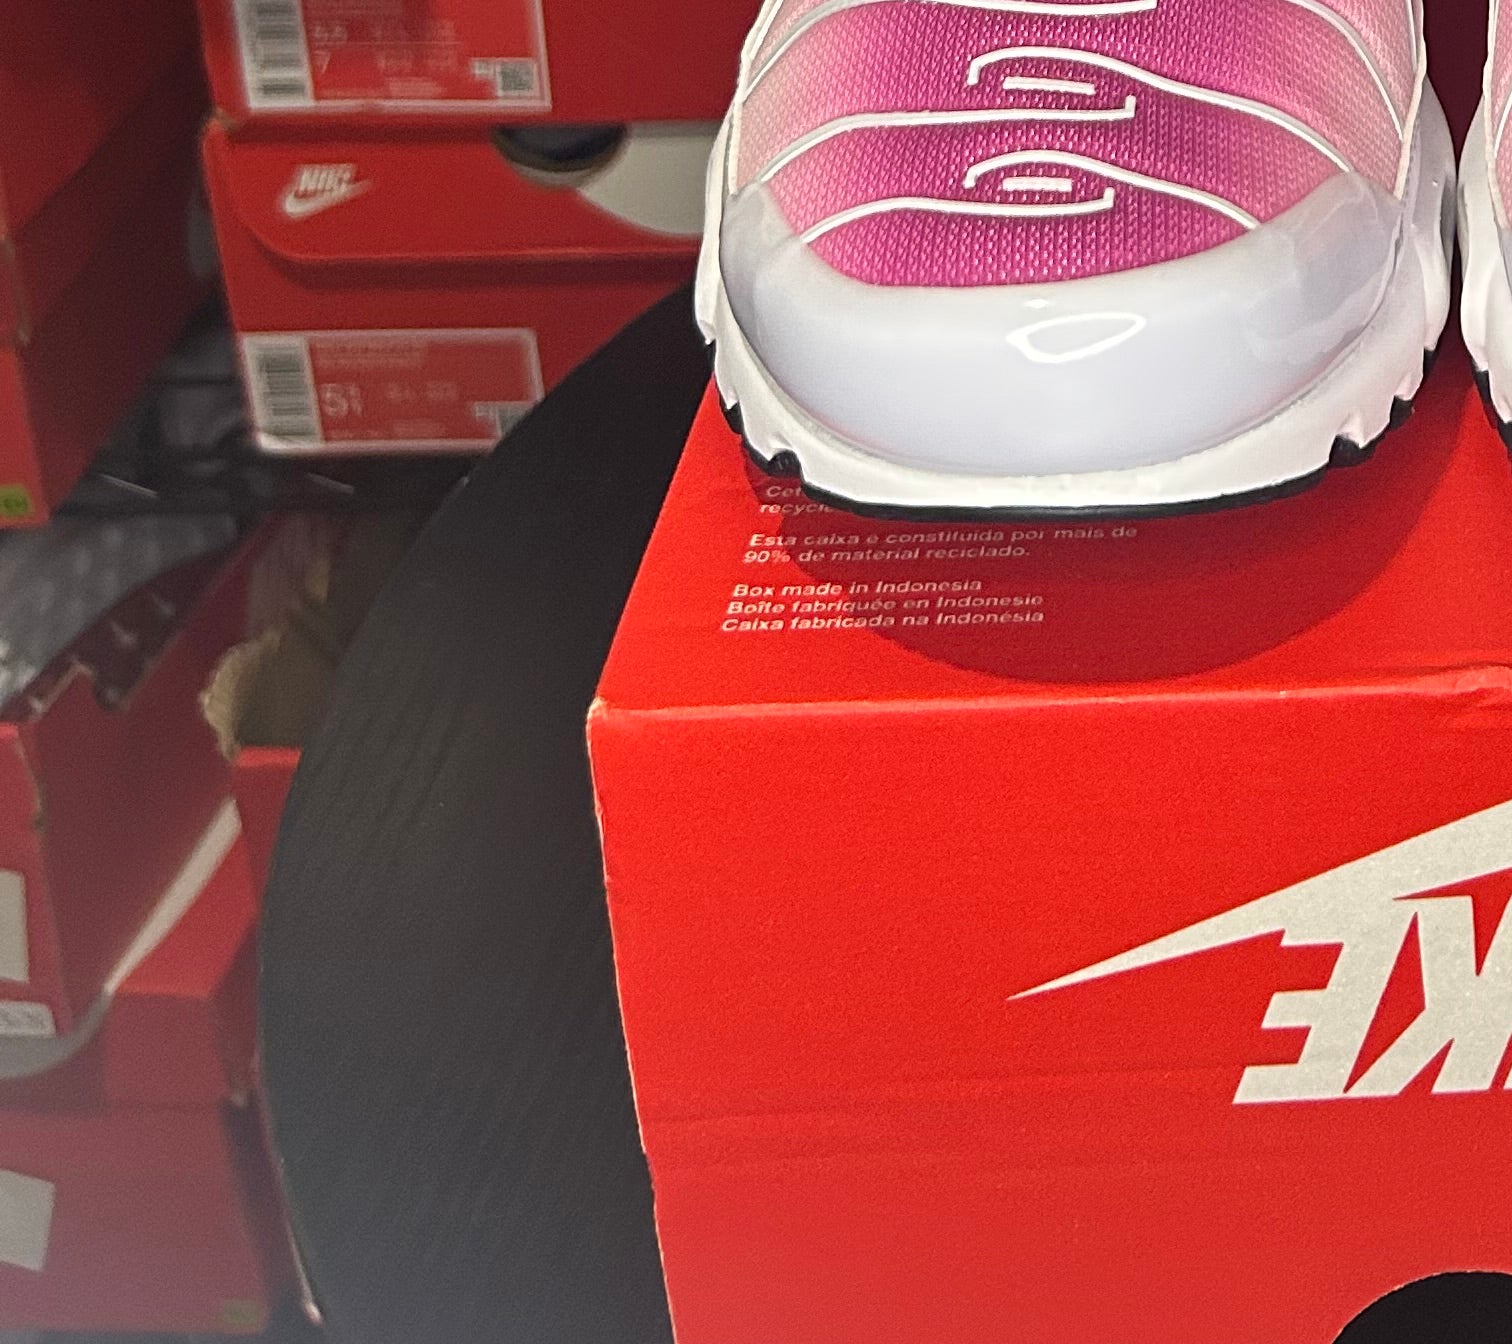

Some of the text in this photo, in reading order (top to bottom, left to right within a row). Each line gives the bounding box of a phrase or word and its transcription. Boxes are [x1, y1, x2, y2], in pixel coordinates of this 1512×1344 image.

[297, 163, 357, 192] NIKE
[750, 533, 797, 546] Esta
[804, 533, 859, 545] caixa
[1011, 529, 1044, 542] por
[1053, 527, 1104, 539] mais
[1111, 526, 1138, 538] de
[743, 545, 1031, 563] 90% de material reciclado.
[733, 579, 982, 597] Box made in Indonesia
[728, 600, 785, 614] Boîte
[902, 598, 930, 609] en
[722, 618, 785, 632] Caixa
[790, 614, 896, 630] fabricada
[902, 614, 930, 626] na
